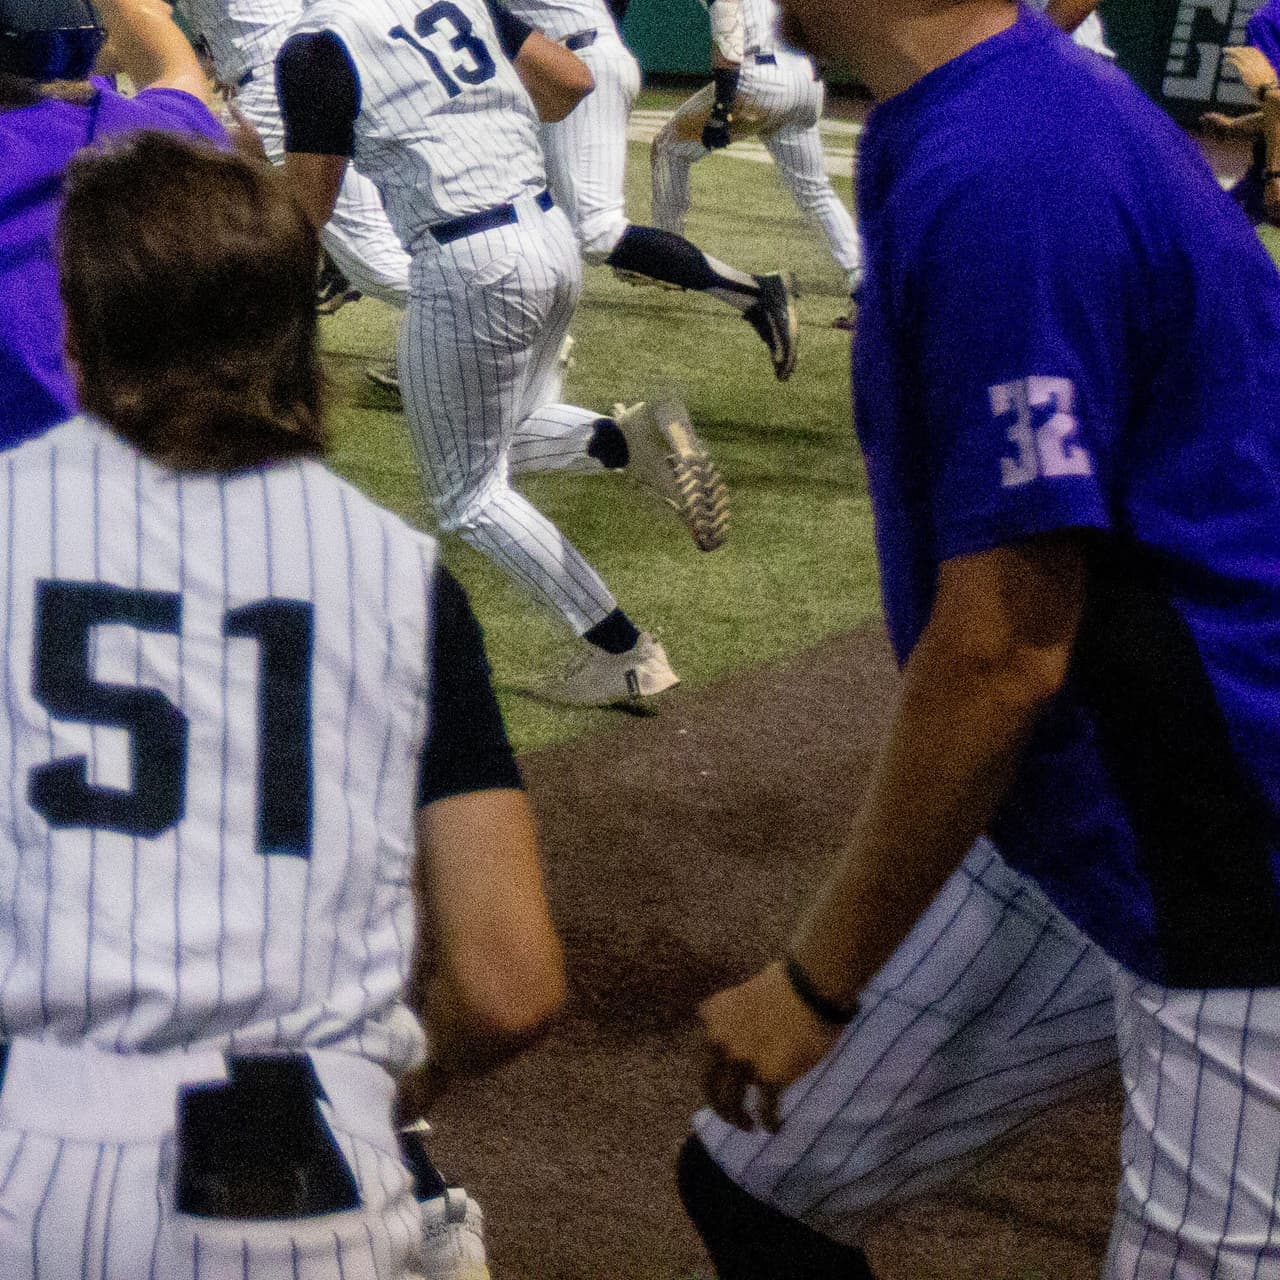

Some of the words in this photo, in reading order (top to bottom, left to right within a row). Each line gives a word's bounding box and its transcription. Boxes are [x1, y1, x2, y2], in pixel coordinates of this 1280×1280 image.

[387, 0, 497, 99] 13
[988, 375, 1092, 488] 32
[27, 578, 315, 861] 51
